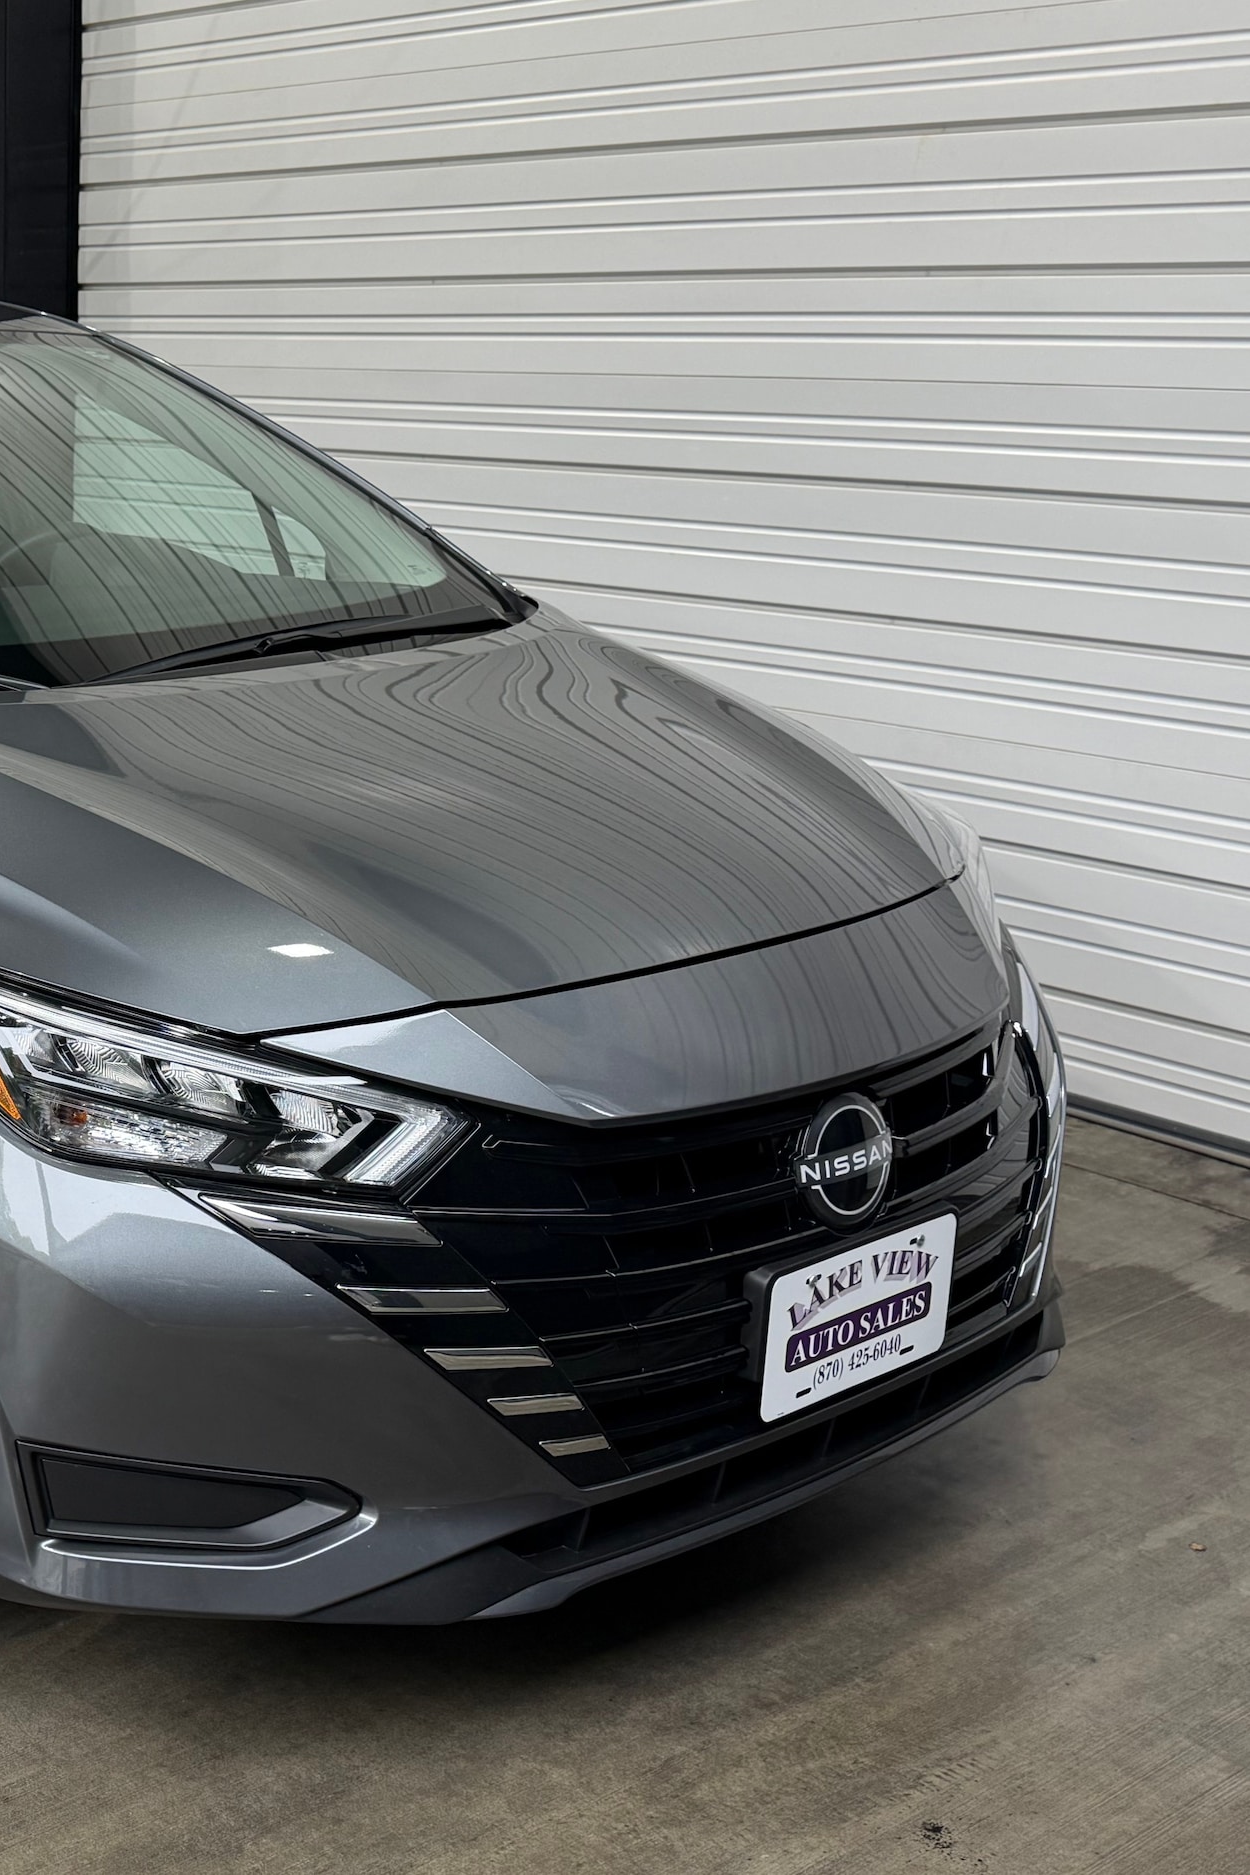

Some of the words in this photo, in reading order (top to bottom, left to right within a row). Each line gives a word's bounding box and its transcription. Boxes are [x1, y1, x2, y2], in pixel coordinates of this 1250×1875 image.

[800, 1139, 892, 1184] NISSAN
[786, 1259, 863, 1331] LAKE
[870, 1249, 939, 1284] VIEW
[790, 1322, 854, 1367] AUTO
[859, 1291, 927, 1340] SALES
[812, 1356, 844, 1391] (870)
[847, 1333, 901, 1372] 425-6040
